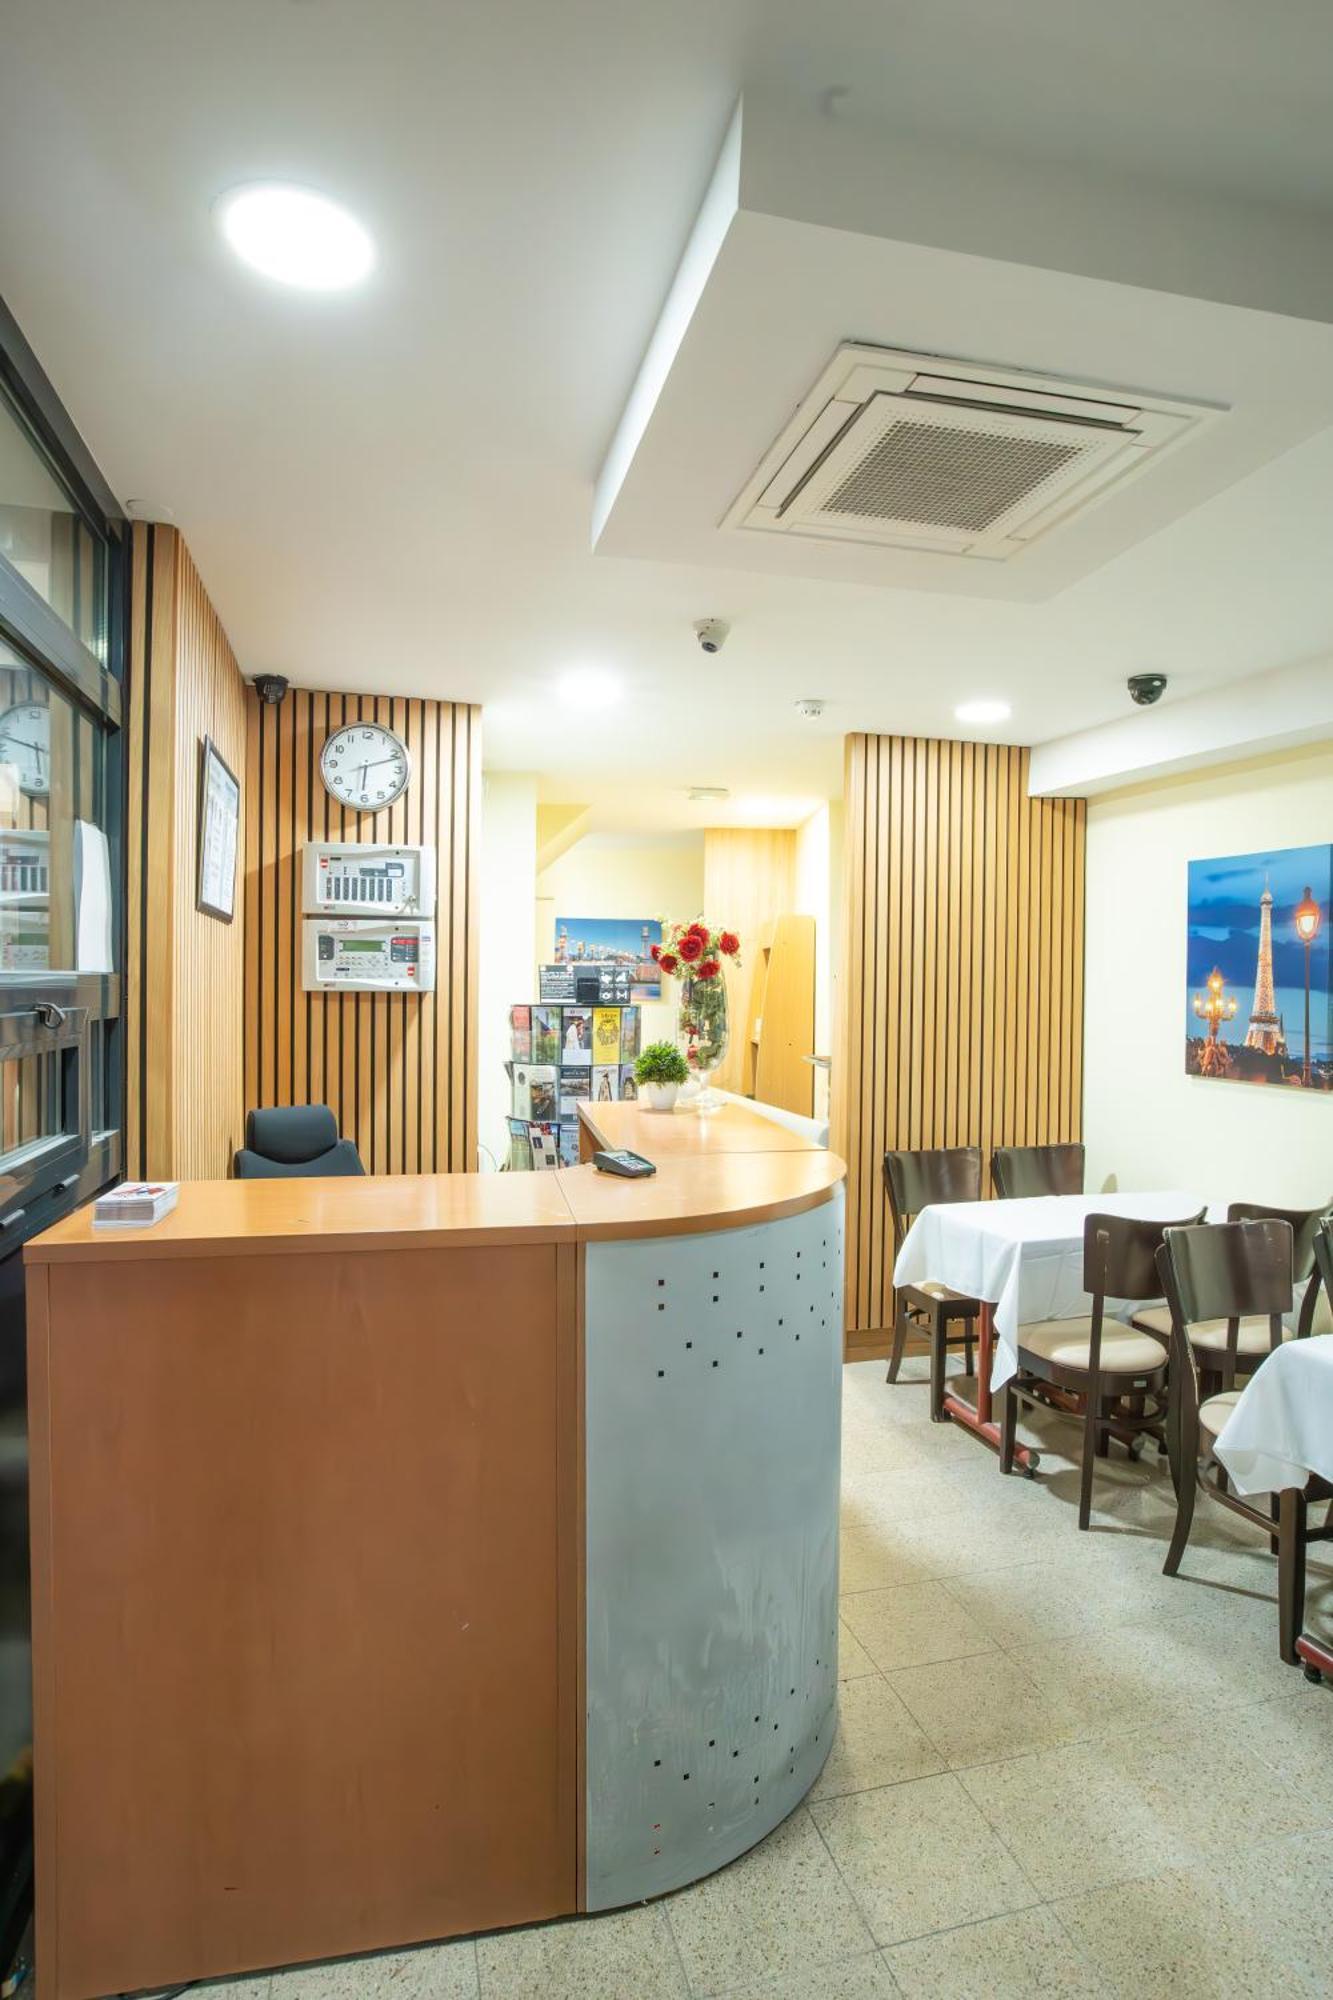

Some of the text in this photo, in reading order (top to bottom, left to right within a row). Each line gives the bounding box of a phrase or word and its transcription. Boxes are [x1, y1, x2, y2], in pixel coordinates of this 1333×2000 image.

[347, 735, 354, 743] 11
[362, 731, 374, 740] 12
[335, 745, 345, 754] 10
[389, 749, 401, 760] 2
[394, 766, 404, 775] 3
[344, 788, 353, 798] 7
[376, 791, 385, 799] 5
[360, 794, 369, 803] 6
